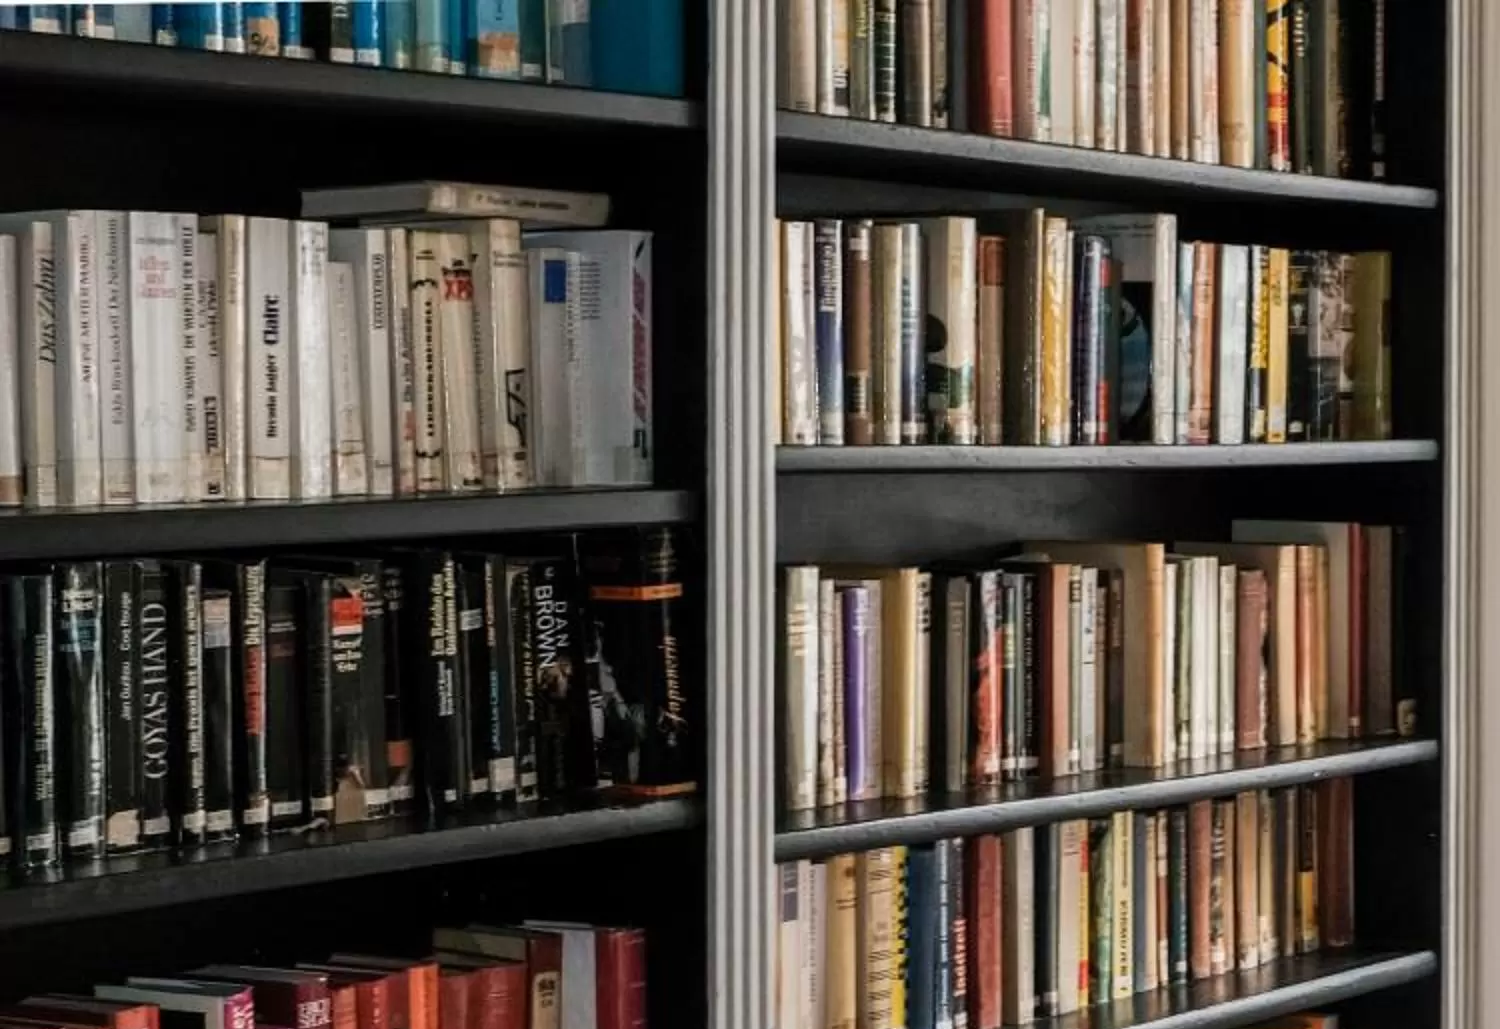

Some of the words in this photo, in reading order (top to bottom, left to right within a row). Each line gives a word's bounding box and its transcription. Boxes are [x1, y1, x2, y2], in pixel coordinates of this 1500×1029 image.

[262, 294, 280, 346] Claire
[140, 602, 168, 685] HAND
[535, 586, 557, 669] BROWN
[555, 602, 570, 648] DAN
[140, 690, 168, 779] GOYAS
